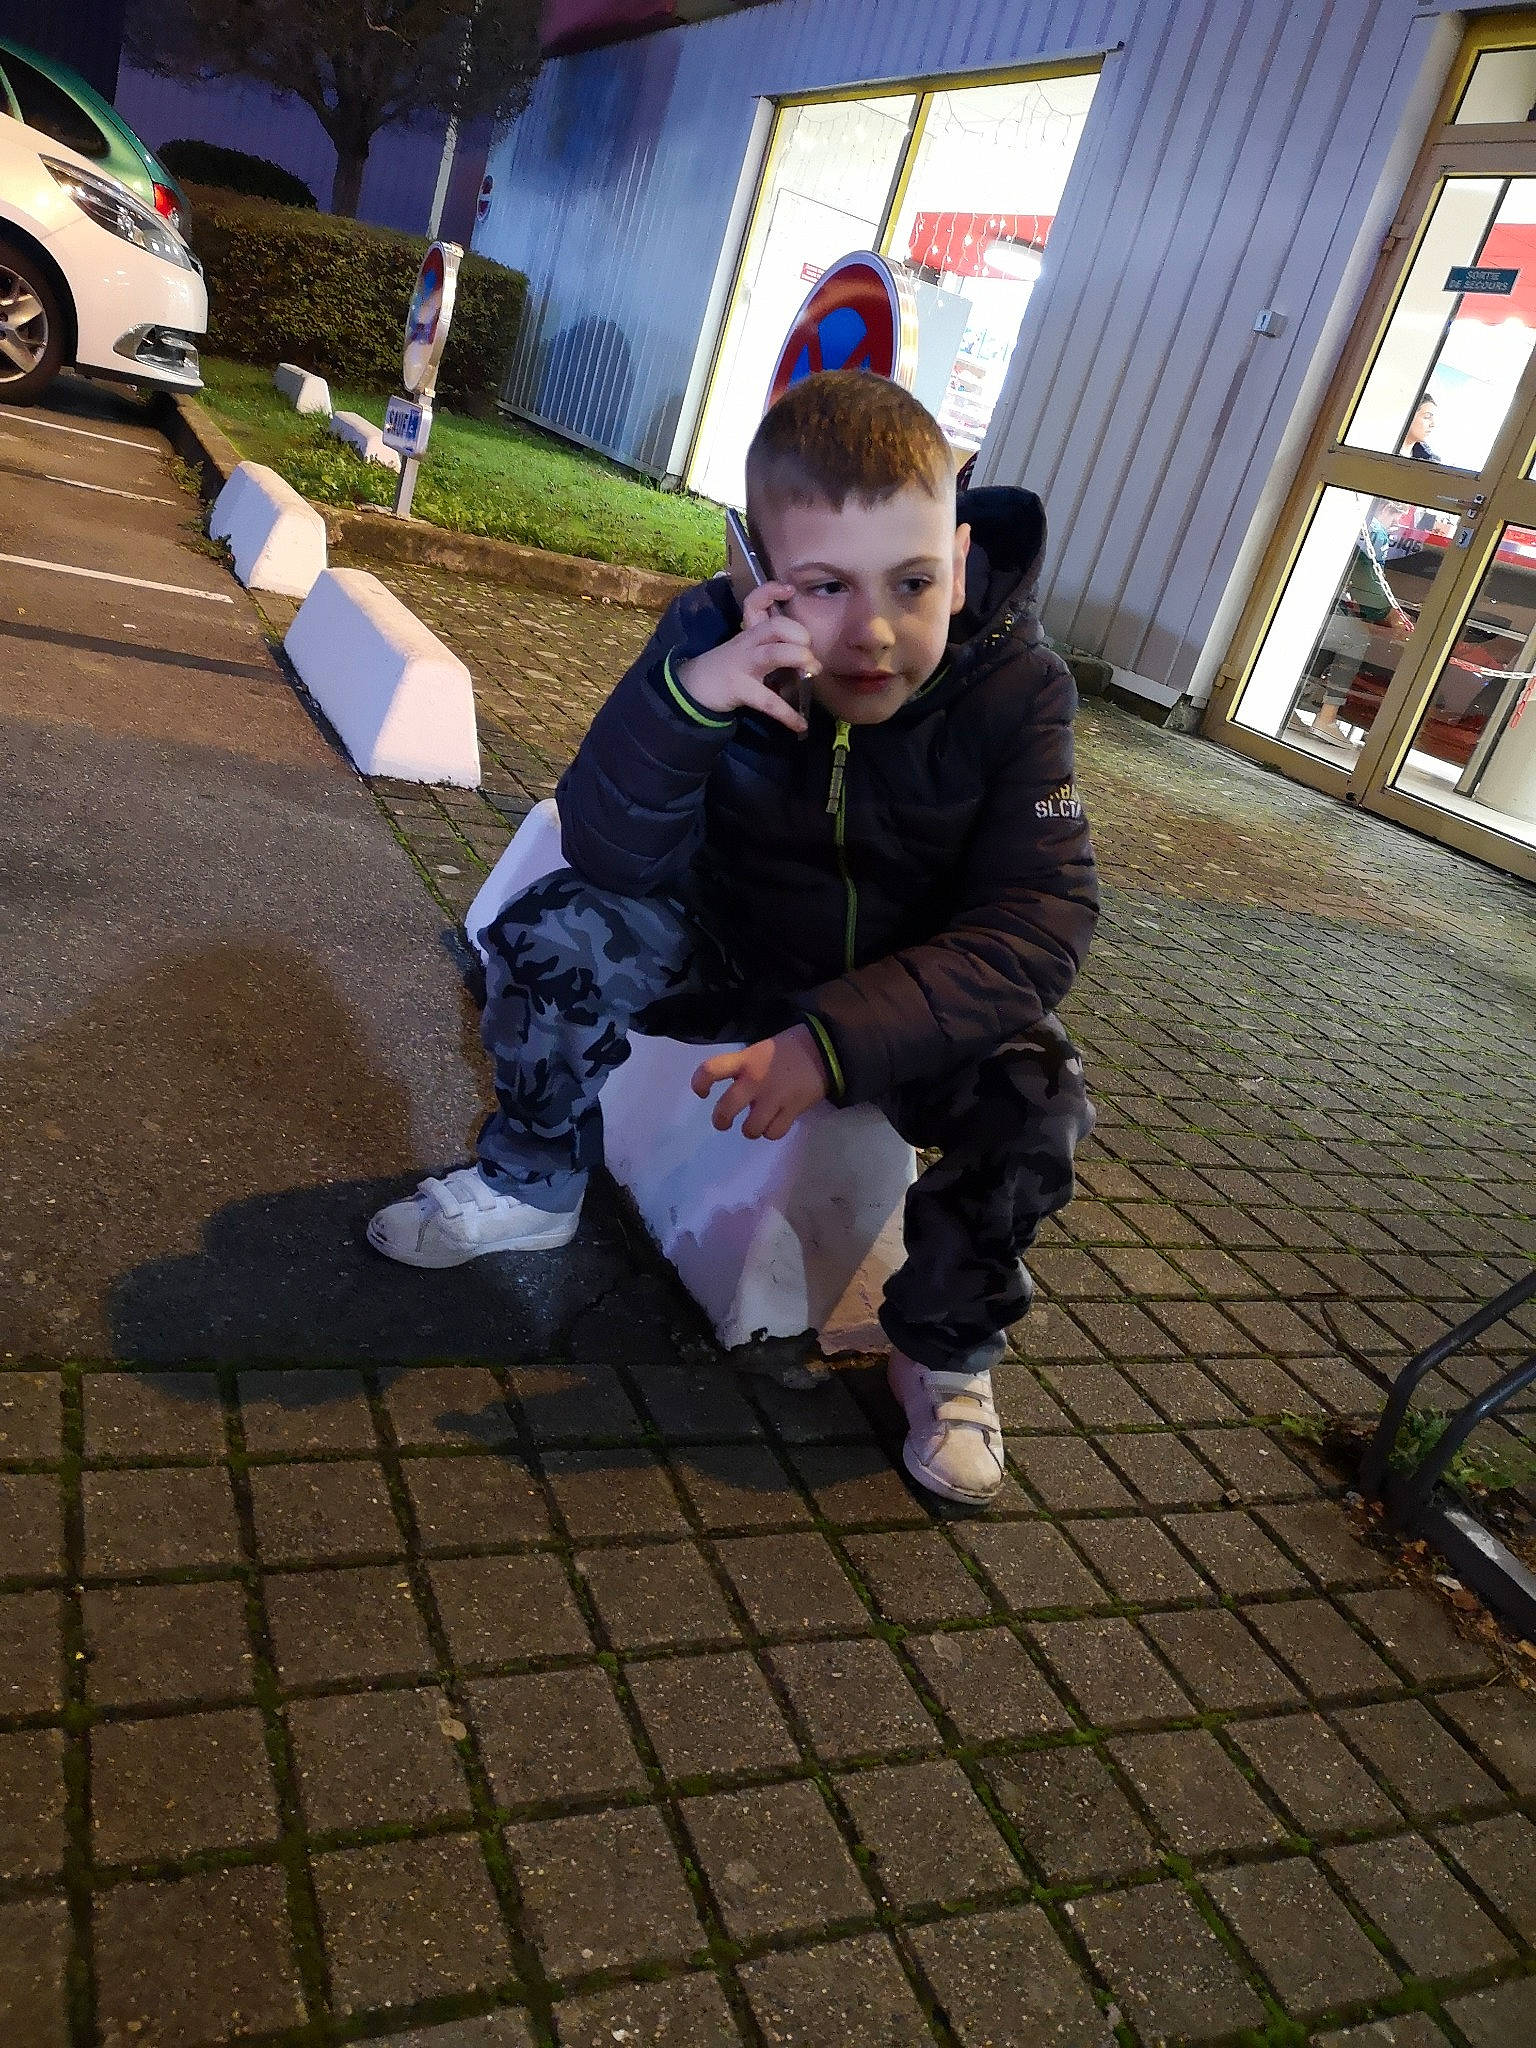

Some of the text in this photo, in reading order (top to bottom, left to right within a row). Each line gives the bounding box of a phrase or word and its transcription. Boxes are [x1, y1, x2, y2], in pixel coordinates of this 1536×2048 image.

[1465, 270, 1501, 281] SORTIE
[1448, 279, 1510, 292] DE SECOURS
